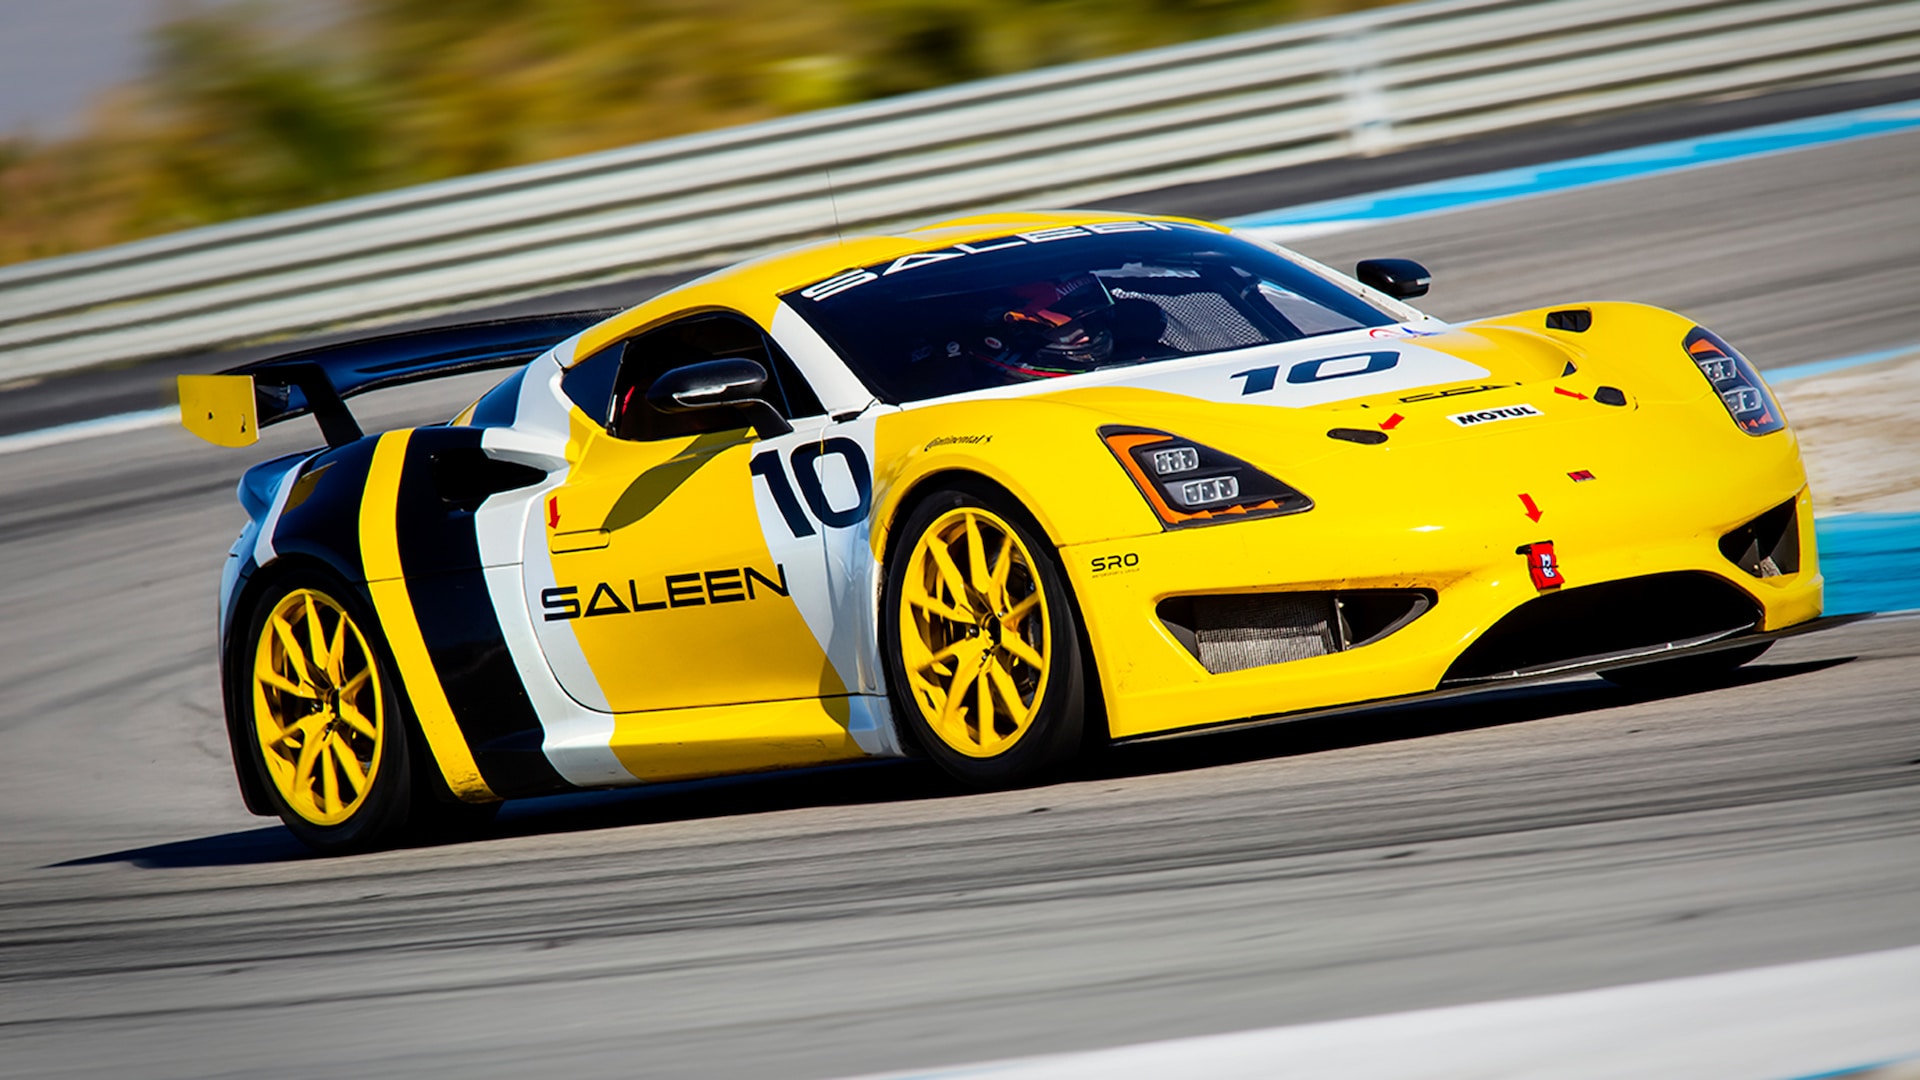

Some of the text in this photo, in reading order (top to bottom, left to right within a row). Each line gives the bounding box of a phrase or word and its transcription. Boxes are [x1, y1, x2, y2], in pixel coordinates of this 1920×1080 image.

[1230, 351, 1400, 395] 10
[1457, 406, 1537, 425] MOTUL
[748, 437, 873, 539] 10
[1091, 553, 1139, 572] SRO
[541, 563, 790, 622] SALEEN
